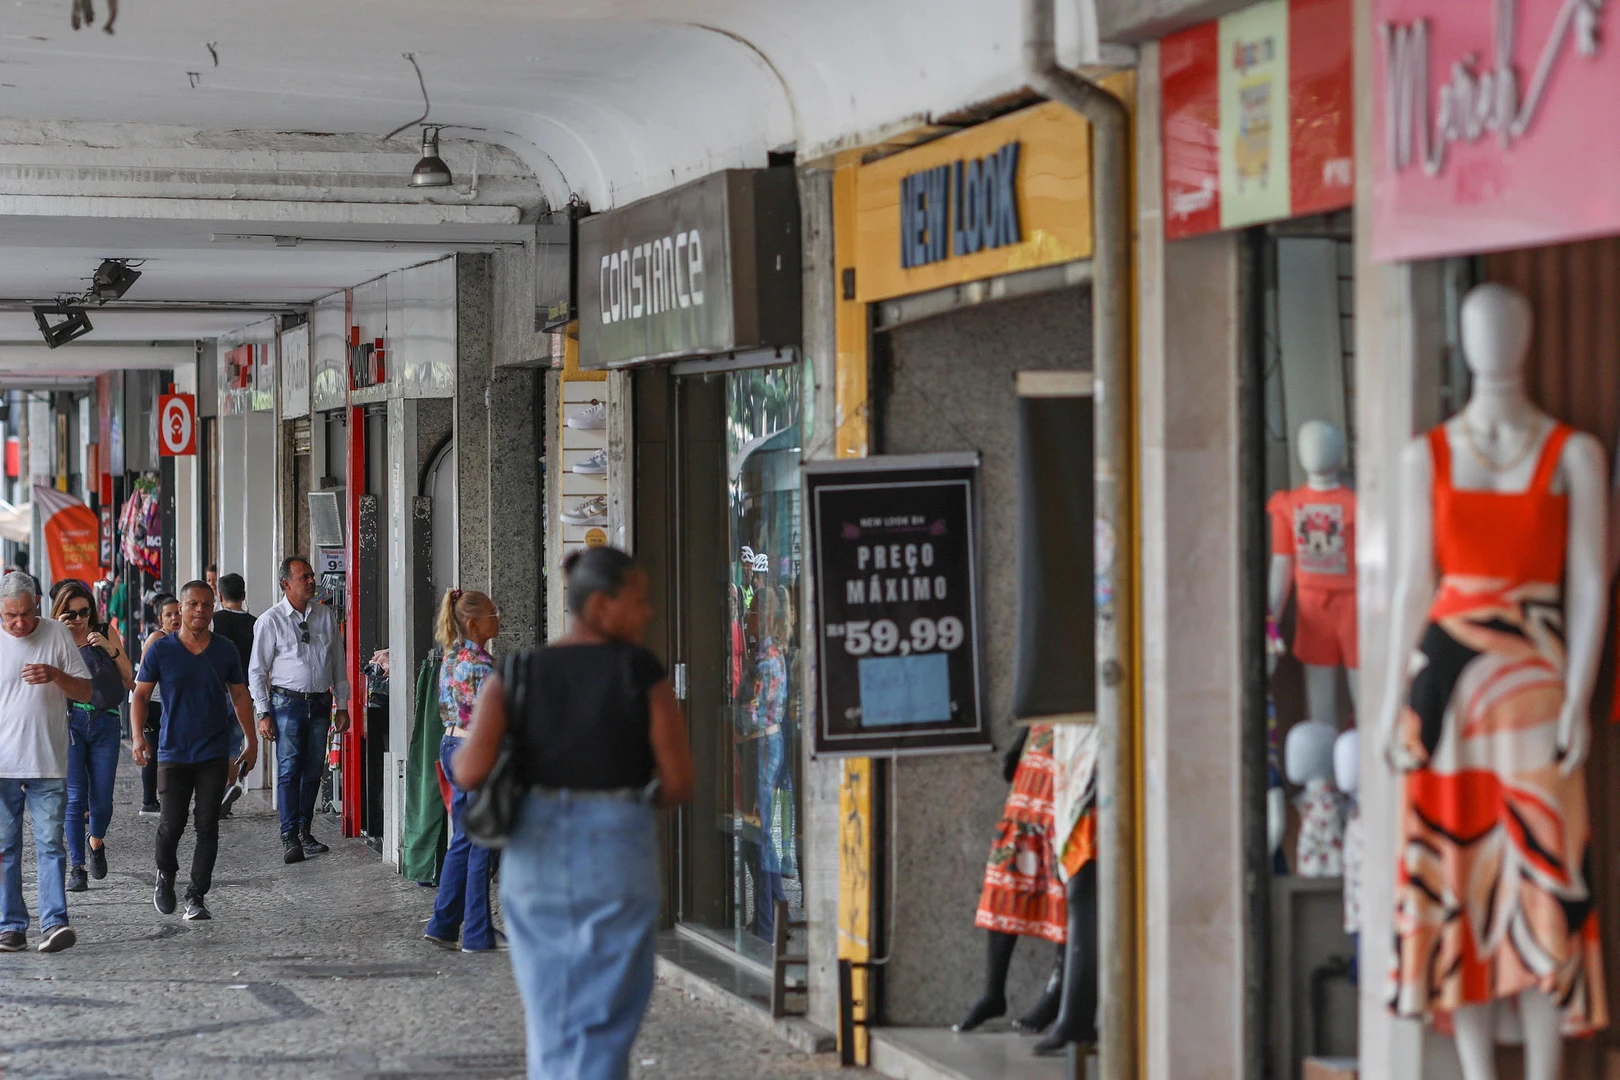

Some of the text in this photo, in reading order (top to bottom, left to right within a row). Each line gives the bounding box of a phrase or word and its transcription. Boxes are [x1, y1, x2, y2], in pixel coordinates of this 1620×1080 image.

[900, 140, 1023, 268] NEW LOOK
[860, 517, 882, 528] NEW
[884, 516, 909, 526] LOOK
[857, 542, 934, 575] PREÇO
[846, 573, 948, 604] MÁXIMO
[844, 616, 964, 656] 59,99
